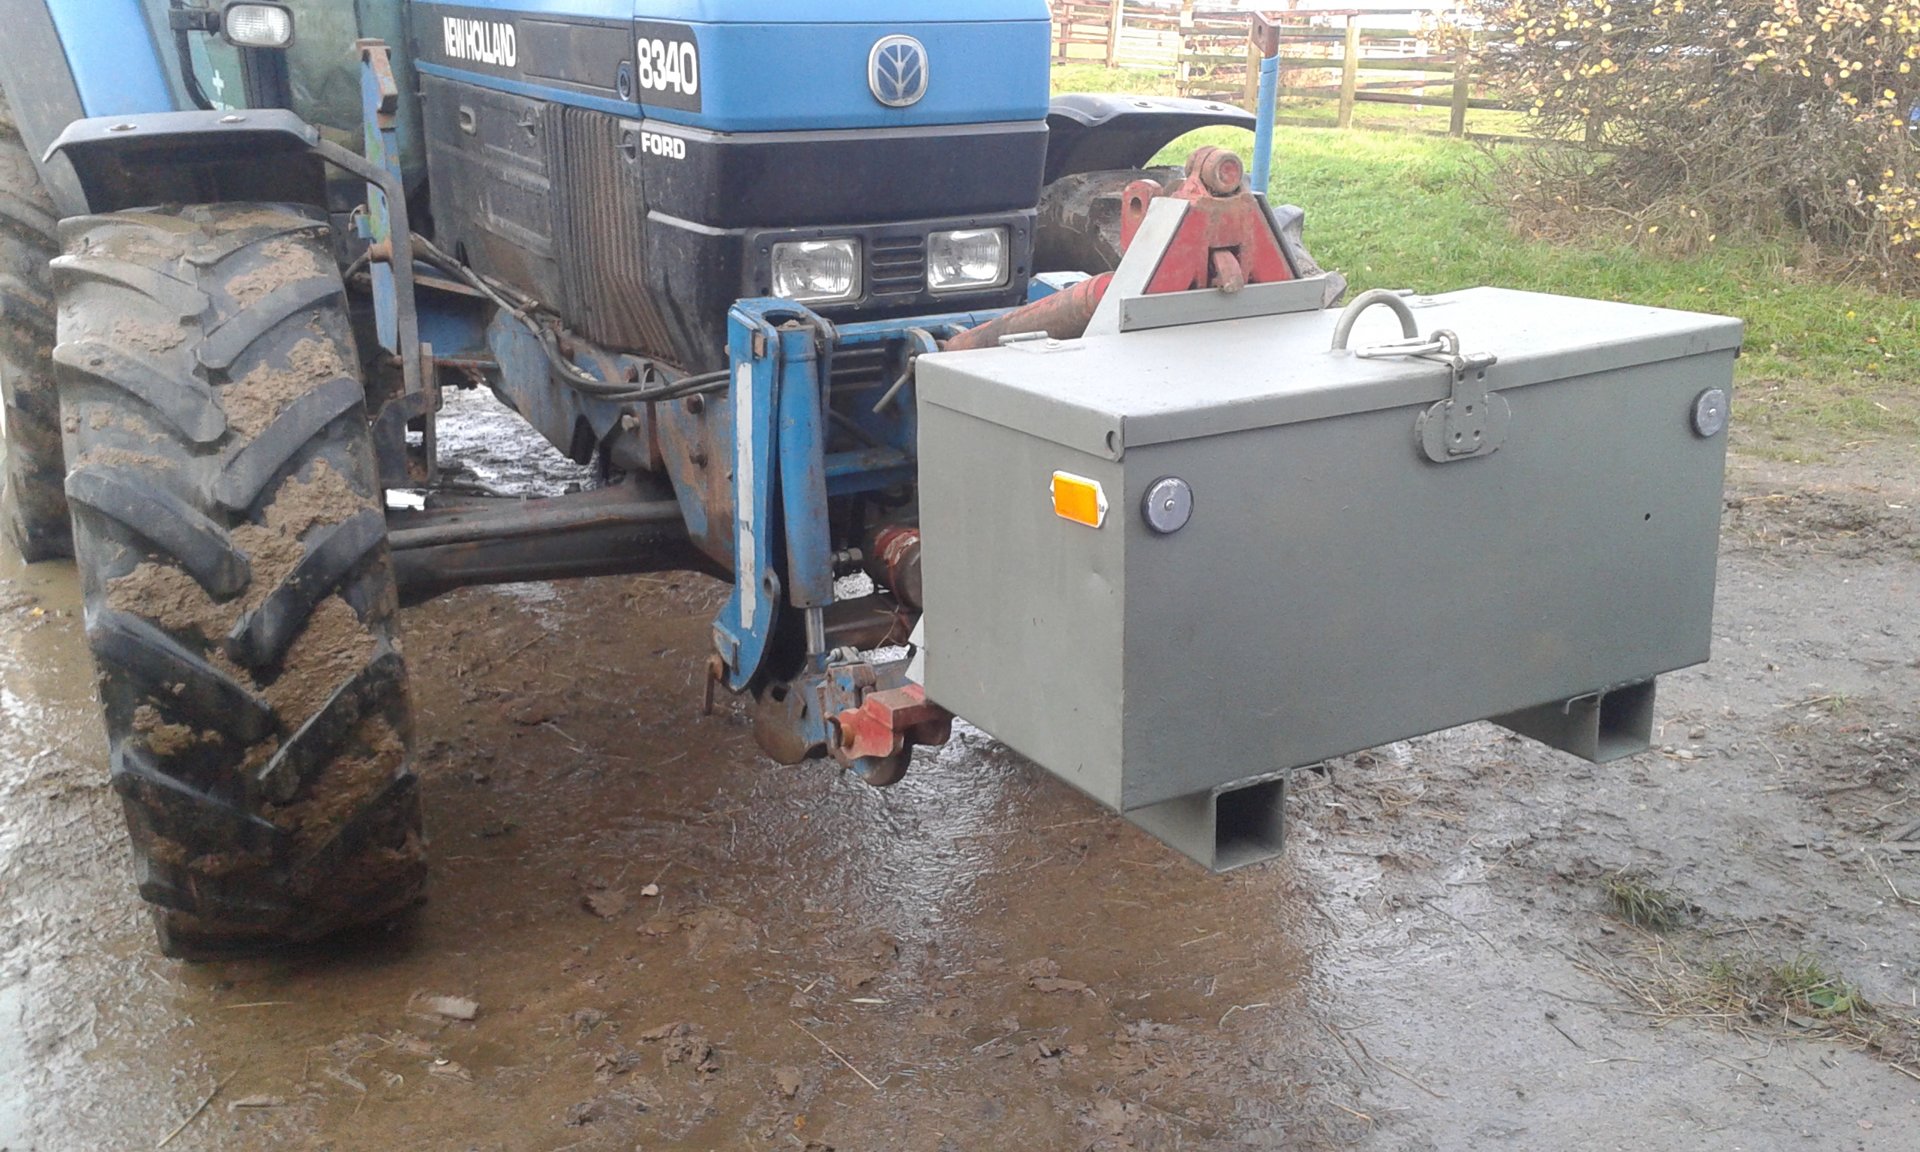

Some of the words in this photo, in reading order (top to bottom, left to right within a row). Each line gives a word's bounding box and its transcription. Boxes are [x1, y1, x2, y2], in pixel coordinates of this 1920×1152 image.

[443, 16, 465, 59] NEW
[464, 20, 516, 68] HOLLAND
[637, 38, 698, 95] 8340
[641, 131, 686, 160] FORD
